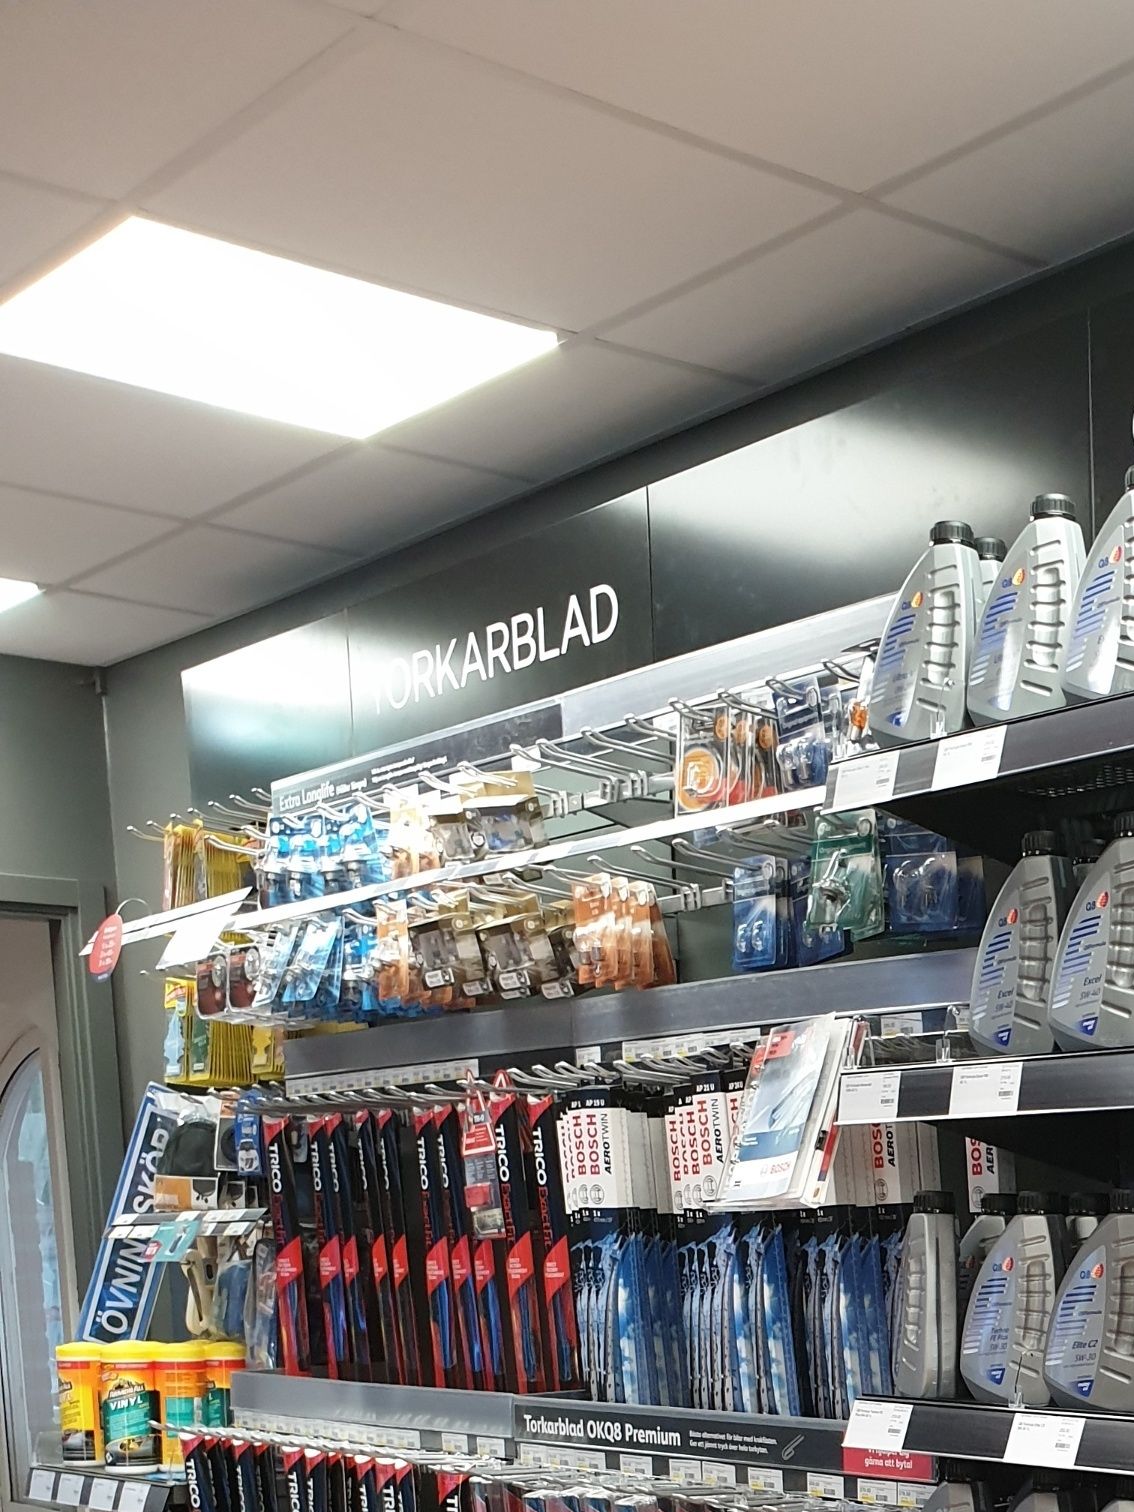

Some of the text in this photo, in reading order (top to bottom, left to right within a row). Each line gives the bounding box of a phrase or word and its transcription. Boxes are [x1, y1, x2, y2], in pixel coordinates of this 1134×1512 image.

[372, 584, 619, 714] ORKARBLAD
[495, 1124, 510, 1182] TRICO
[532, 1126, 548, 1185] TRICO
[572, 1114, 587, 1175] BOSCH
[586, 1113, 600, 1175] BOSCH
[600, 1112, 612, 1174] AEROTWIN
[686, 1110, 701, 1175] BOSCH
[698, 1099, 713, 1165] BOSCH
[711, 1097, 724, 1163] AEROTWIN
[268, 1142, 282, 1194] TRICO
[310, 1141, 322, 1191] TRICO
[328, 1142, 340, 1193] TRICO
[416, 1136, 429, 1191] TRICO
[437, 1133, 450, 1188] TRICO
[110, 1397, 144, 1411] VINYL
[523, 1414, 584, 1438] Torkarblad
[587, 1420, 622, 1441] OKQ8
[625, 1423, 681, 1447] Premium
[185, 1458, 200, 1509] TRICO
